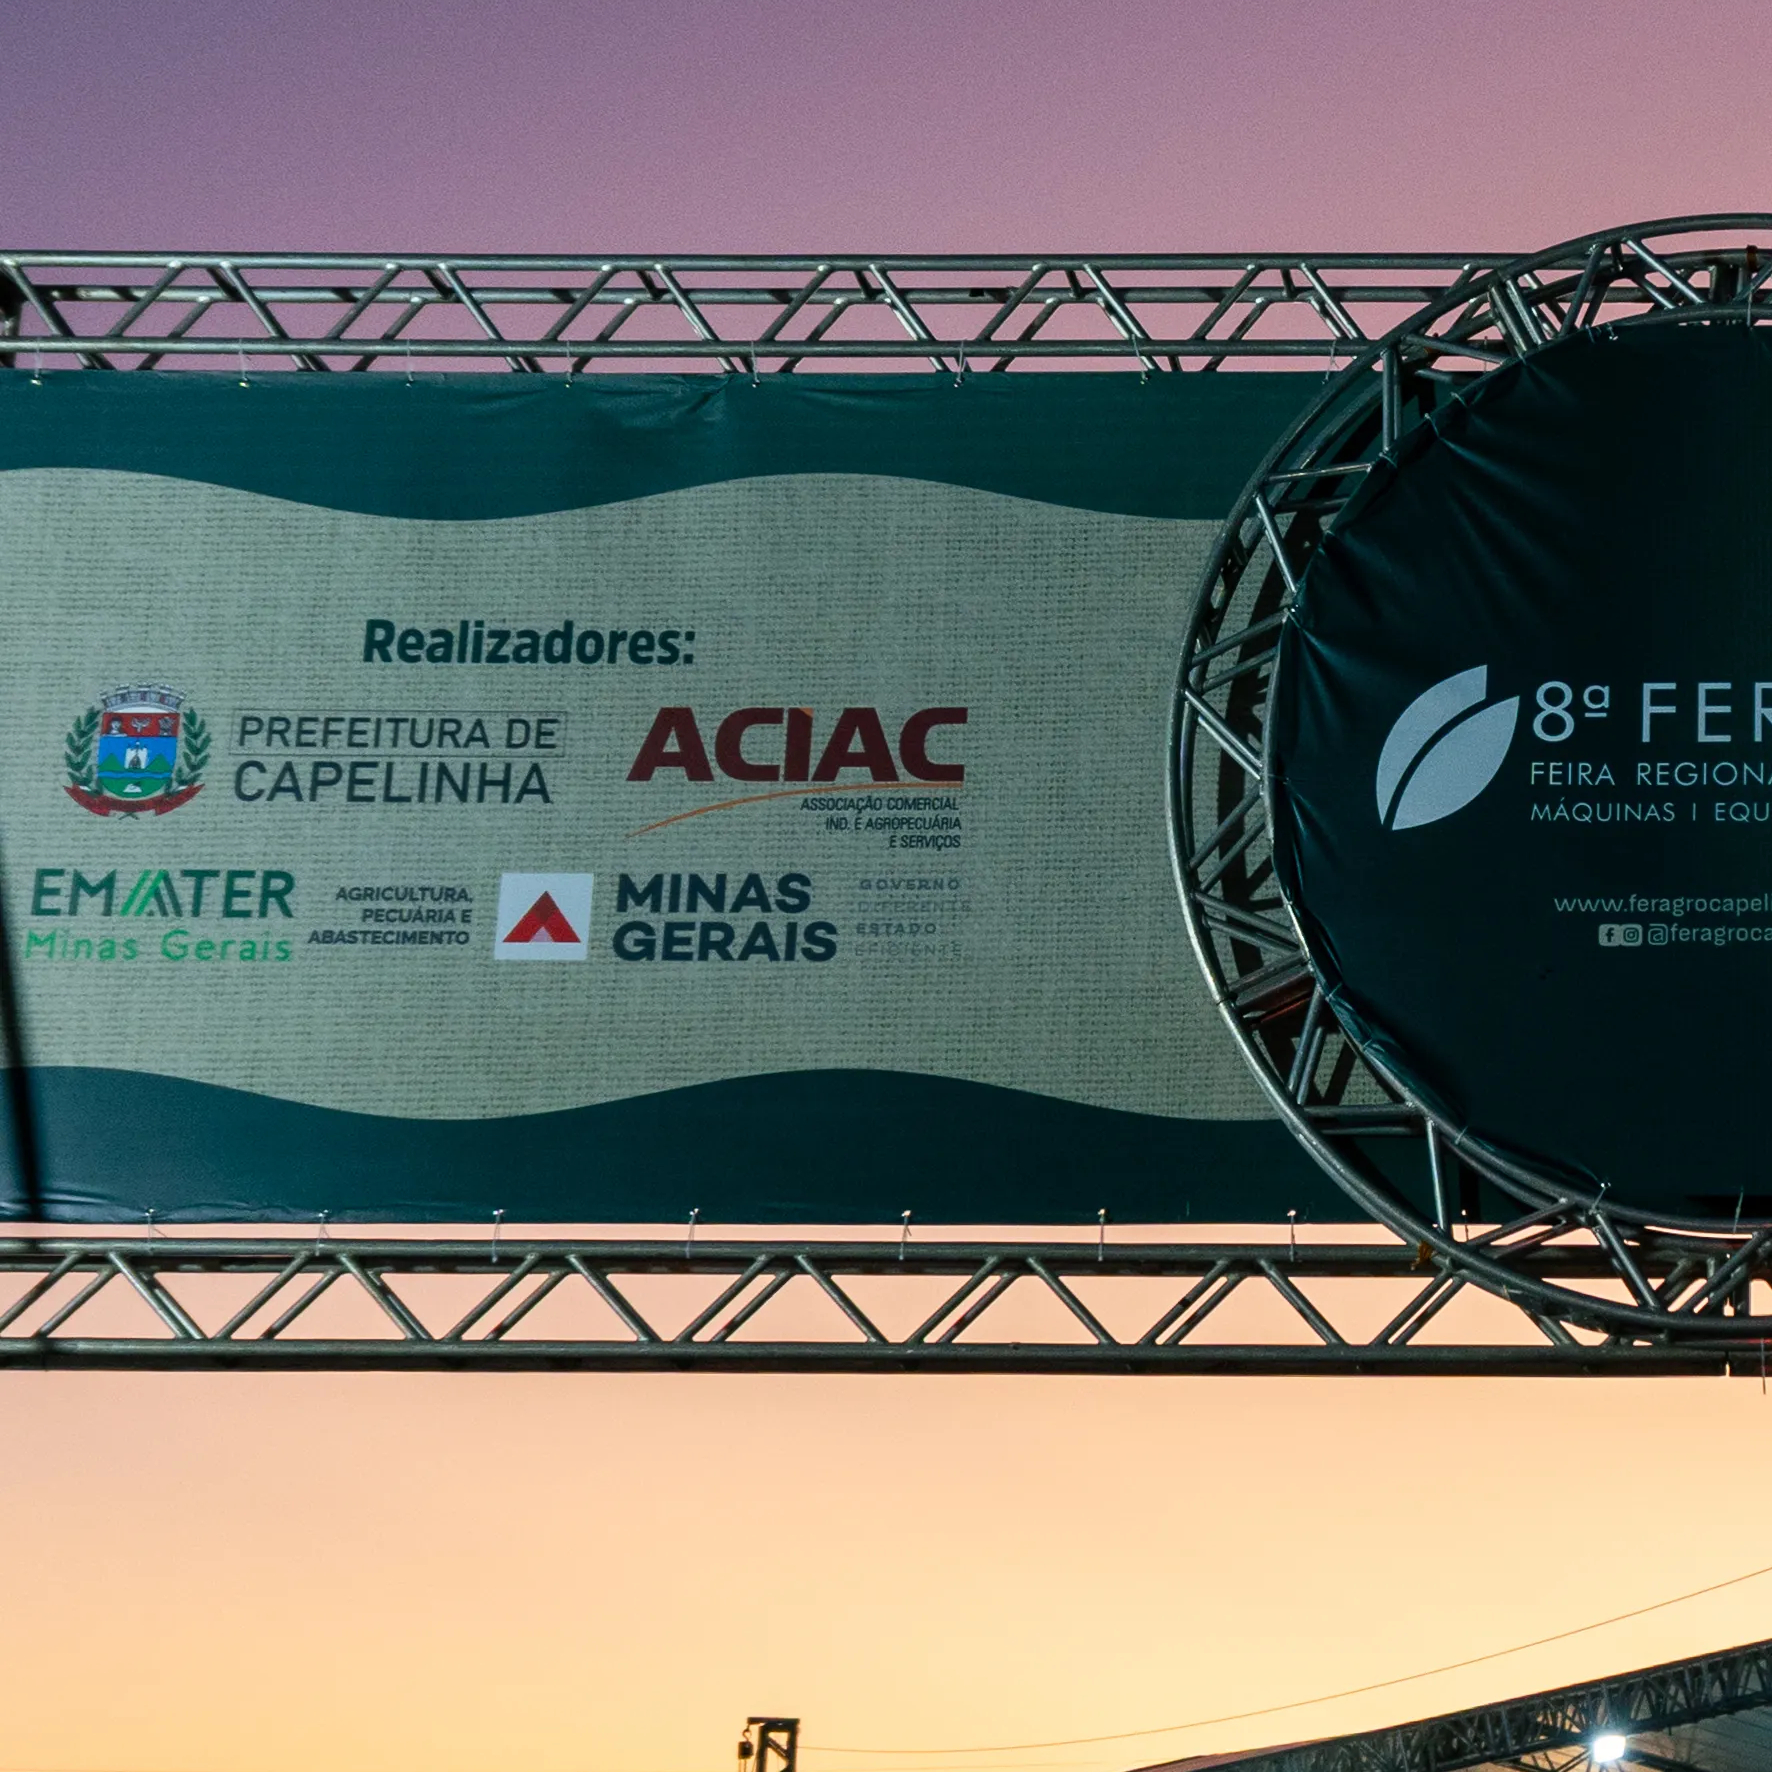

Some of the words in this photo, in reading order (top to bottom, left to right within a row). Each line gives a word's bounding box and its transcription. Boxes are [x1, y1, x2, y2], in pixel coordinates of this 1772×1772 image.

[363, 618, 695, 665] Realizadores:
[238, 715, 490, 749] PREFEITURA
[505, 717, 559, 749] DE
[626, 706, 968, 782] ACIAC
[234, 760, 552, 804] CAPELINHA
[1530, 761, 1616, 786] FEIRA
[800, 795, 883, 814] ASSOCIAÇÃO
[886, 797, 960, 811] COMERCIAL
[1530, 796, 1676, 824] MÁQUINAS
[825, 816, 851, 831] IND.
[854, 817, 862, 830] E
[864, 814, 962, 830] AGROPECUÁRIA
[889, 835, 897, 849] E
[901, 834, 961, 851] SERVIÇOS
[30, 868, 295, 919] EMATER
[335, 886, 474, 903] AGRICULTURA,
[617, 872, 812, 914] MINAS
[361, 905, 456, 923] PECUÁRIA
[461, 908, 473, 924] E
[25, 929, 138, 962] Minas
[161, 929, 293, 962] Gerais
[308, 930, 470, 945] ABASTECIMENTO
[612, 920, 838, 962] GERAIS
